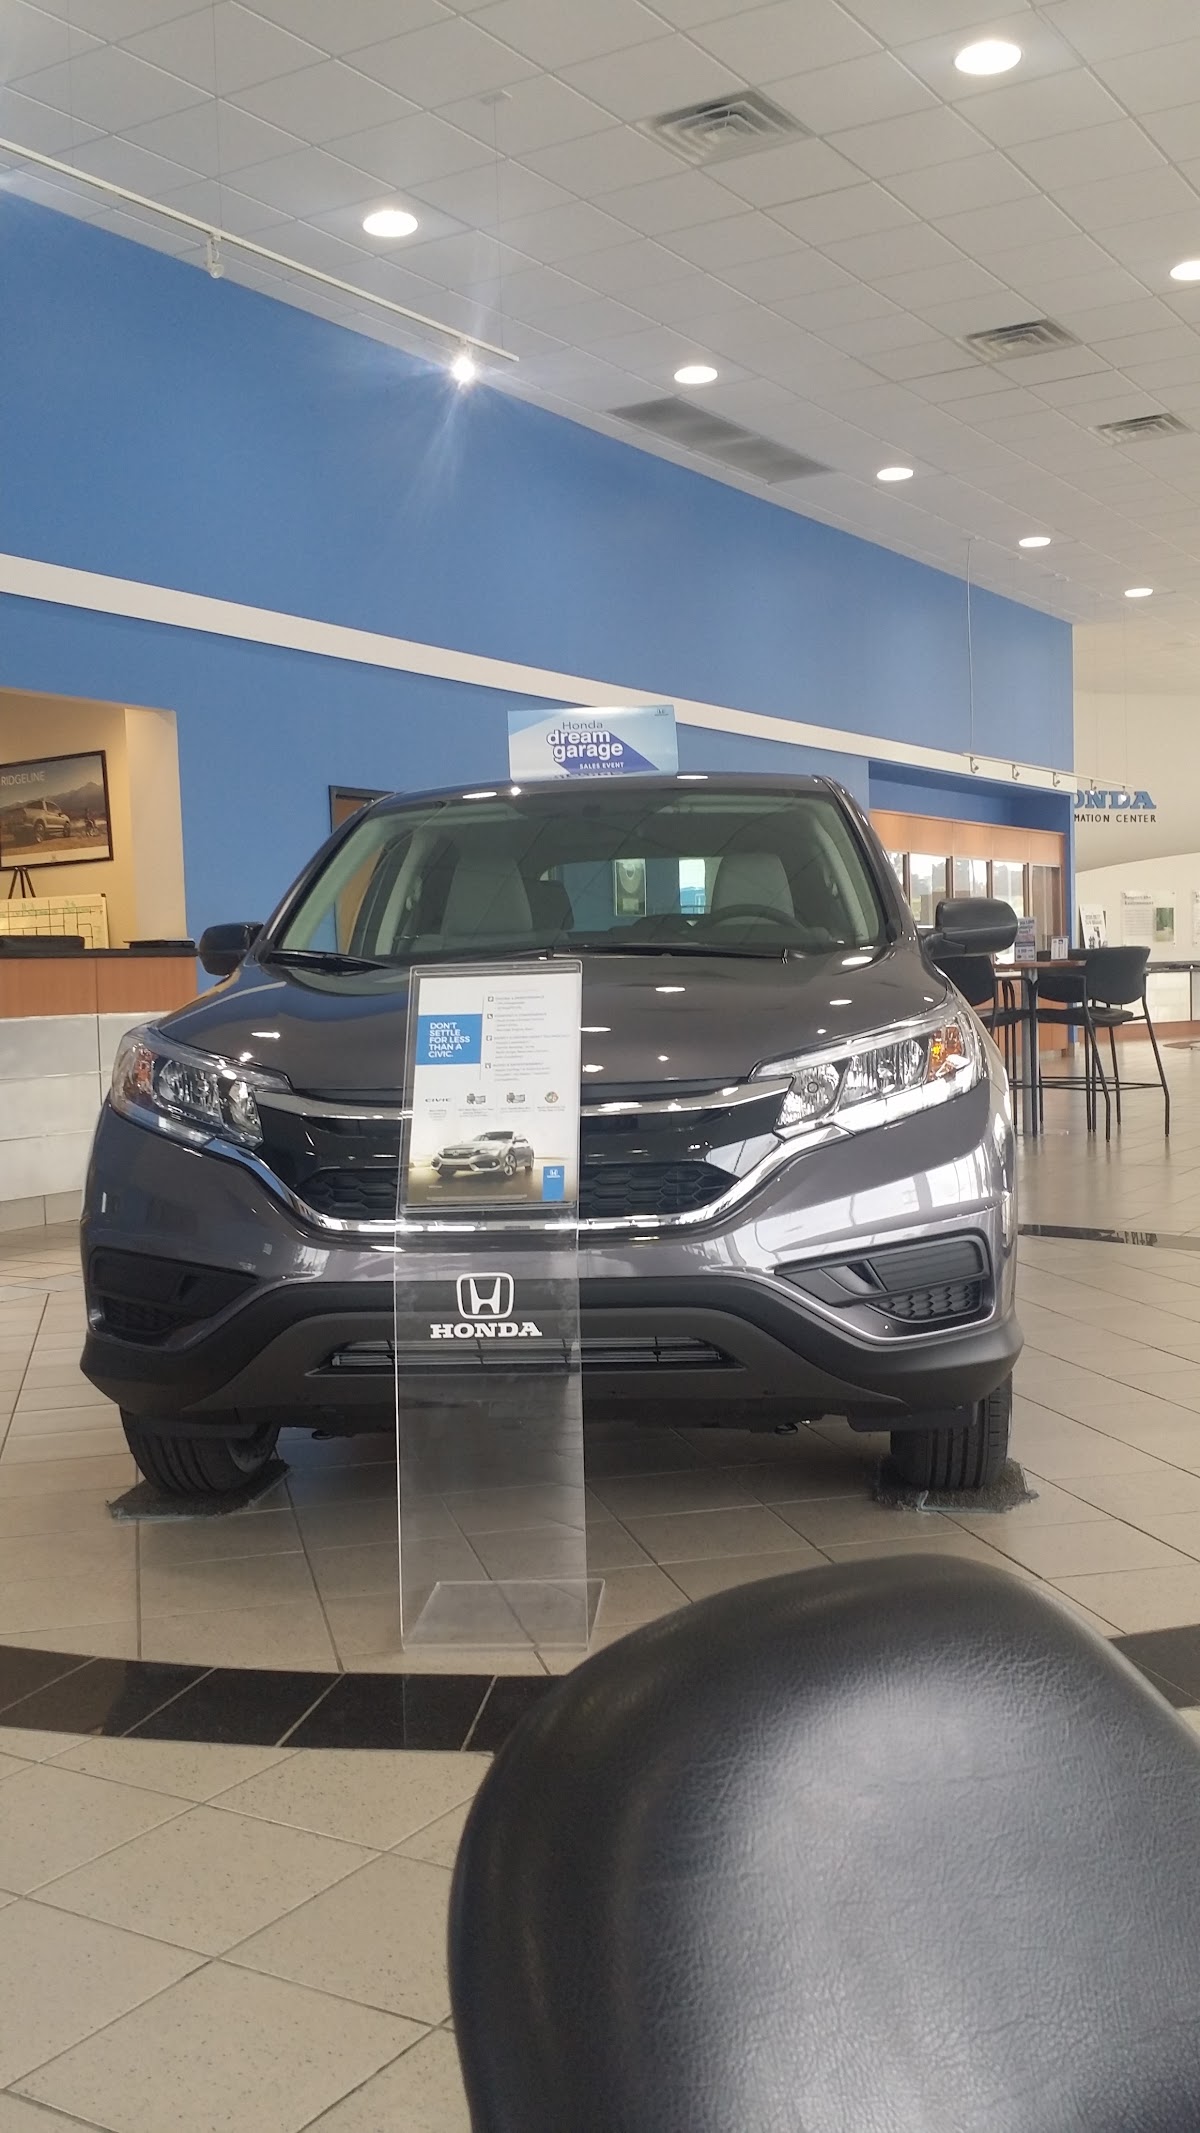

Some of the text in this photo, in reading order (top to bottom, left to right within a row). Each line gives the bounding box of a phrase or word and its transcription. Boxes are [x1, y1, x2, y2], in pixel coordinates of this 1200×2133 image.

[562, 720, 603, 730] Honda
[547, 730, 610, 745] dream
[553, 743, 623, 762] garage
[1, 771, 46, 786] RIDGELINE
[1116, 814, 1157, 823] CENTER
[430, 1022, 457, 1030] DON'T
[429, 1029, 461, 1037] SETTLE
[429, 1035, 471, 1044] FOR LESS
[429, 1043, 454, 1051] THAN
[430, 1321, 543, 1339] HONDA
